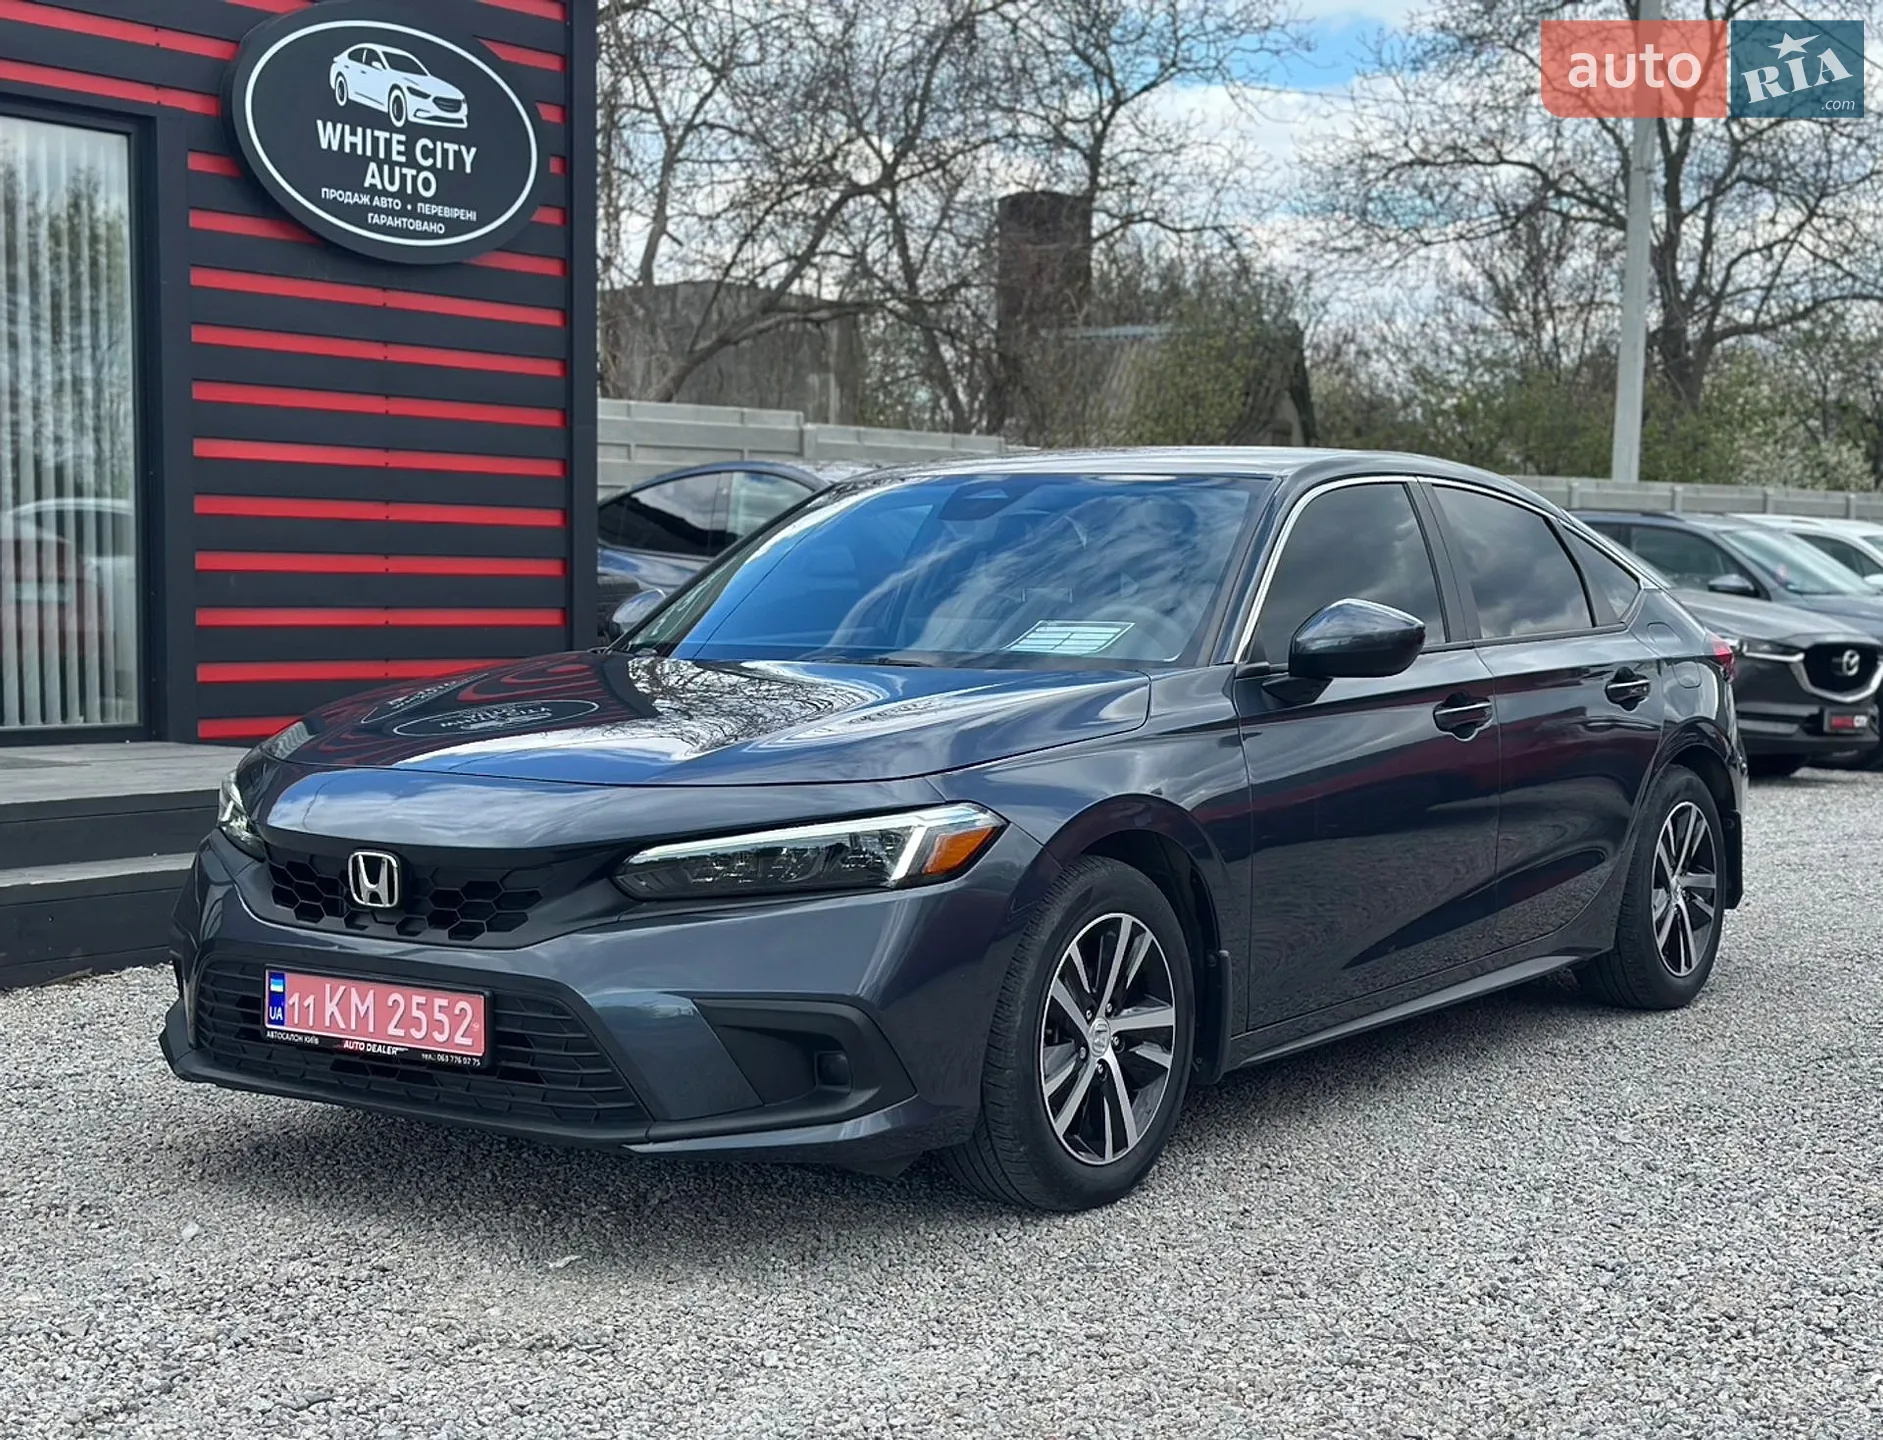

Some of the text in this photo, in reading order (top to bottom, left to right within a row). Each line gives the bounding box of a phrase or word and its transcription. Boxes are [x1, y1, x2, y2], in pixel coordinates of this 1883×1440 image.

[316, 119, 477, 174] WHITE CITY
[363, 161, 437, 198] AUTO
[321, 187, 477, 222] ПРОДАЖ АВТО ПЕРЕВІРЕНІ
[367, 212, 446, 235] ГАРАНТОВАНО
[269, 1006, 284, 1021] UA
[386, 992, 474, 1046] 2552
[343, 1040, 365, 1051] AUTO
[366, 1043, 397, 1056] DEALER
